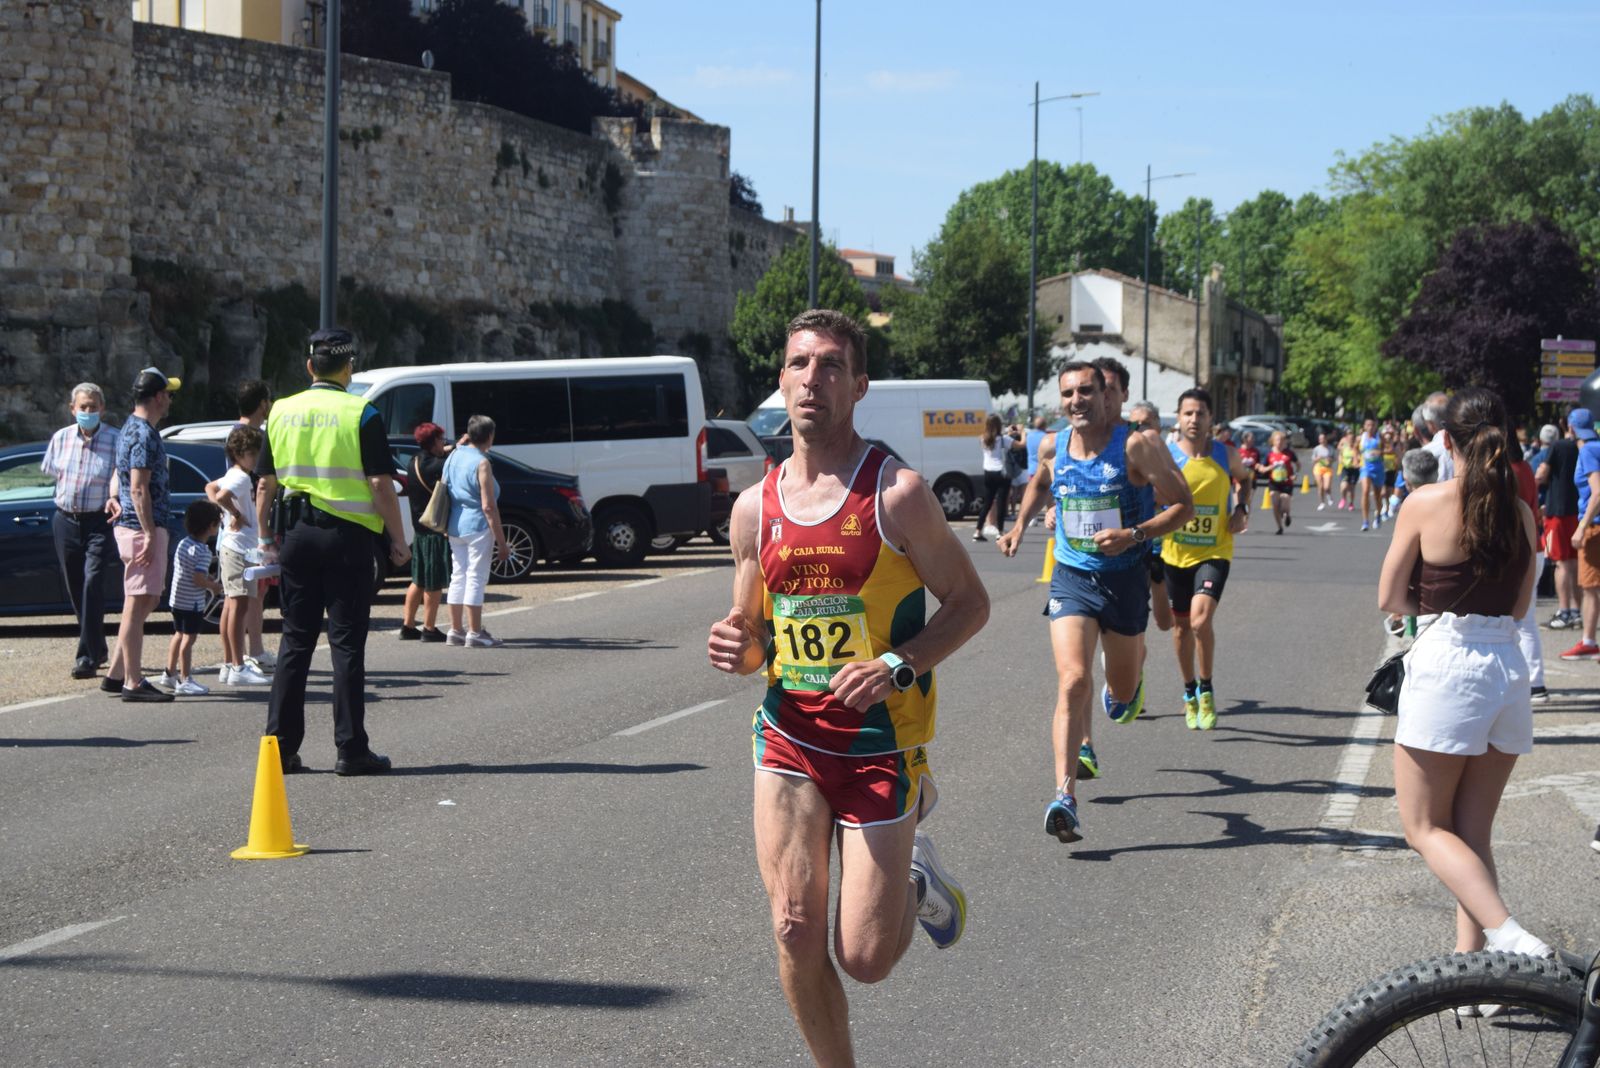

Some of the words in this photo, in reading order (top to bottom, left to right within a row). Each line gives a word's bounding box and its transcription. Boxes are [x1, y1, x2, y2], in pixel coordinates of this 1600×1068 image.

[283, 413, 340, 428] POLICIA
[793, 548, 815, 556] CAJA
[816, 546, 845, 554] RURAL
[792, 563, 829, 575] VINO
[782, 579, 800, 592] DE
[804, 577, 844, 588] TORO
[791, 596, 848, 607] FUNDACION
[816, 605, 849, 615] RURAL
[783, 621, 856, 661] 182
[803, 673, 828, 684] CAJA
